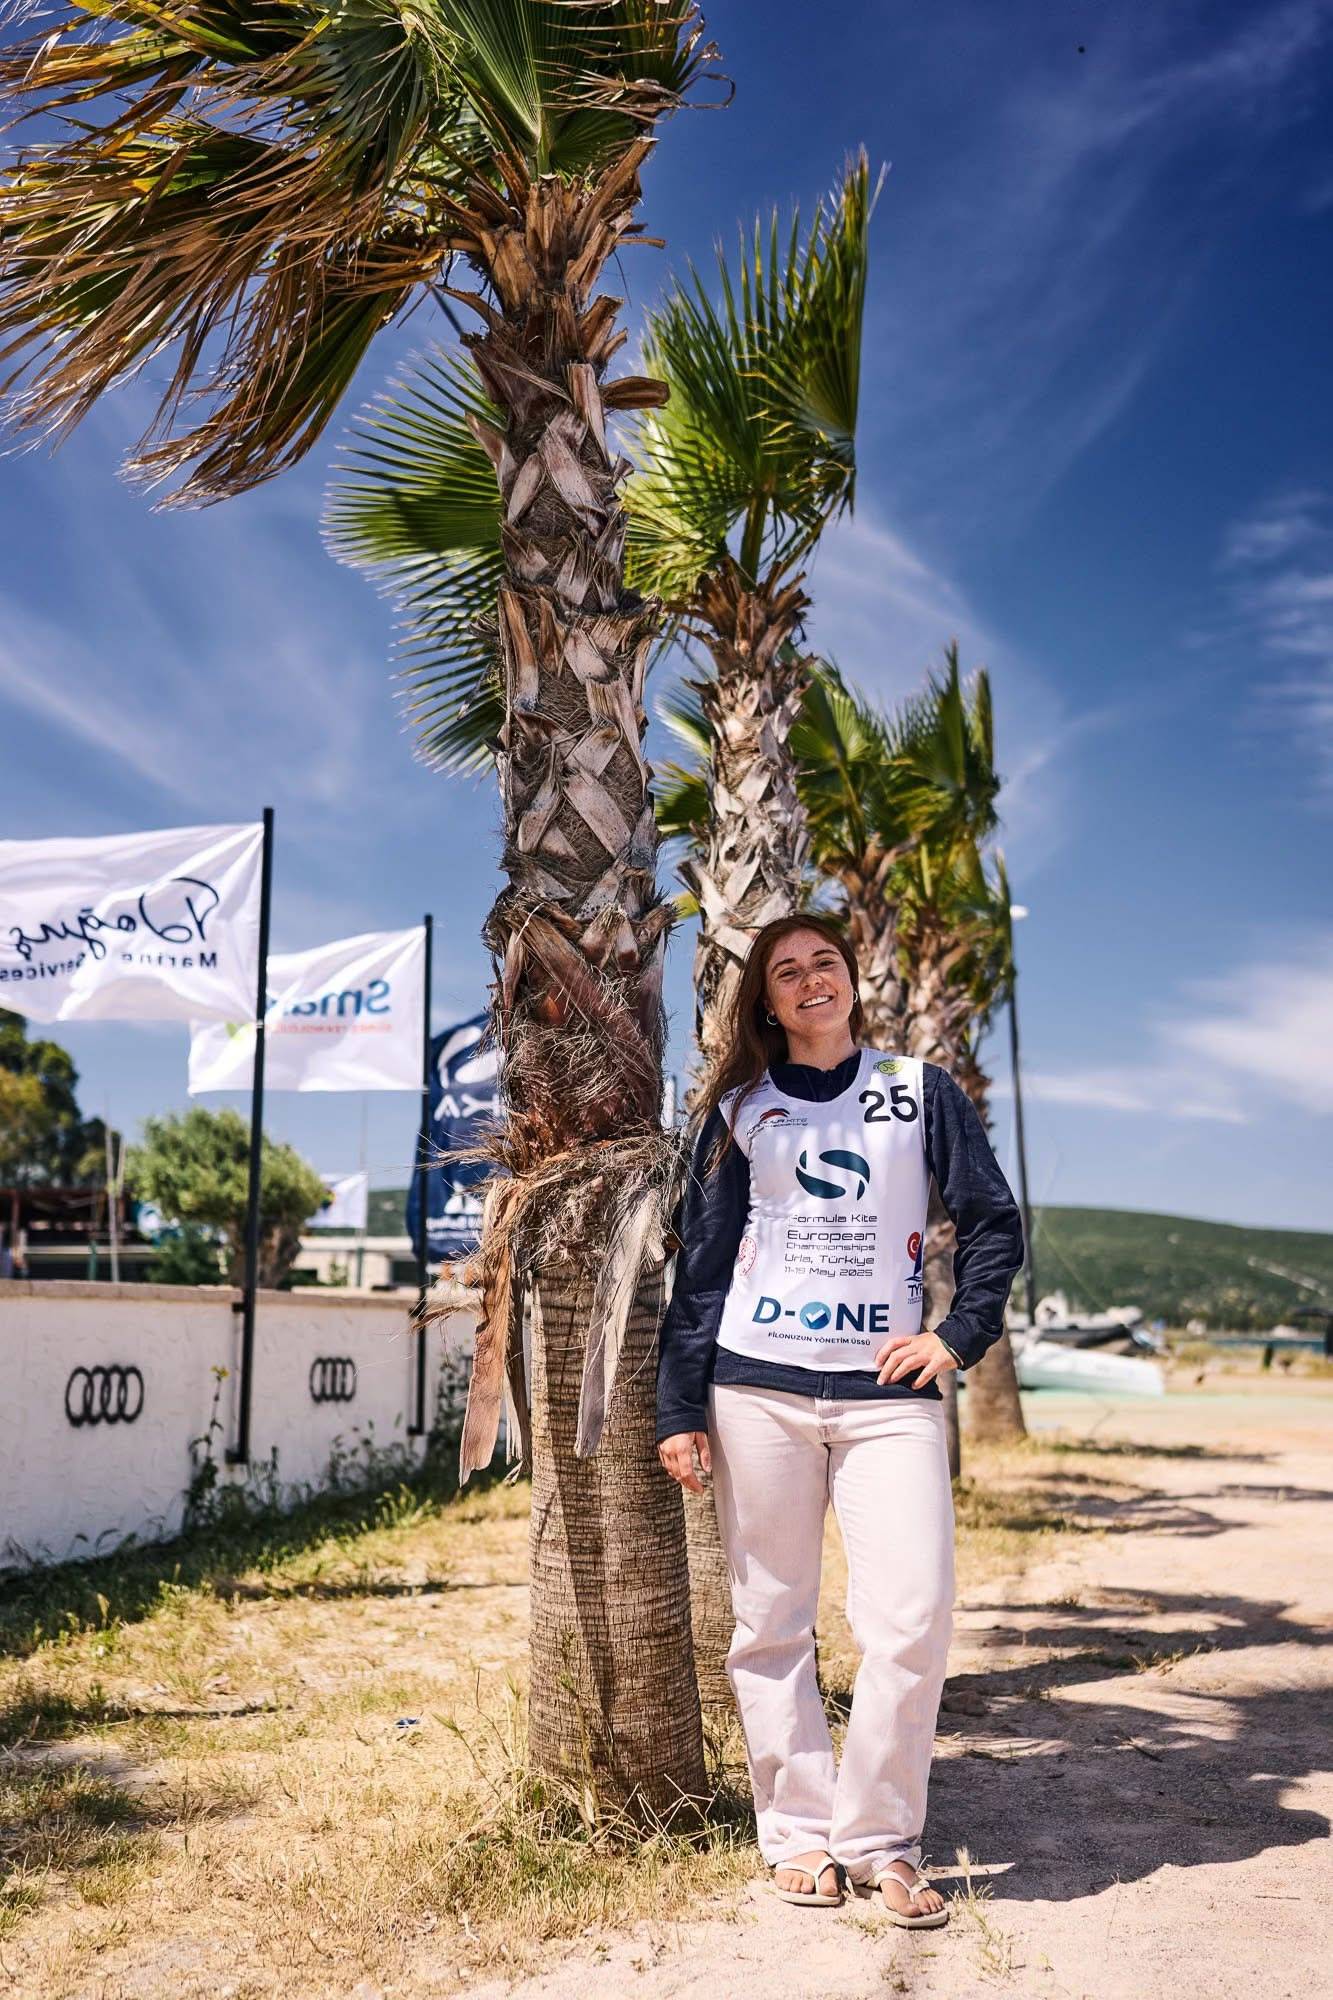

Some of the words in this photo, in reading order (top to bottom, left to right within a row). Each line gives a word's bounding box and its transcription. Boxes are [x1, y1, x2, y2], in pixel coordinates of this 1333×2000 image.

[859, 1084, 919, 1123] 25
[851, 1213, 878, 1223] Kite
[787, 1229, 876, 1243] European
[786, 1242, 876, 1252] Championships
[784, 1253, 813, 1264] Urla,
[819, 1254, 875, 1267] Türkiye
[809, 1267, 836, 1277] May
[840, 1268, 873, 1277] 2025
[814, 1335, 850, 1345] YÖNETİM
[851, 1338, 871, 1346] ÜSSÜ
